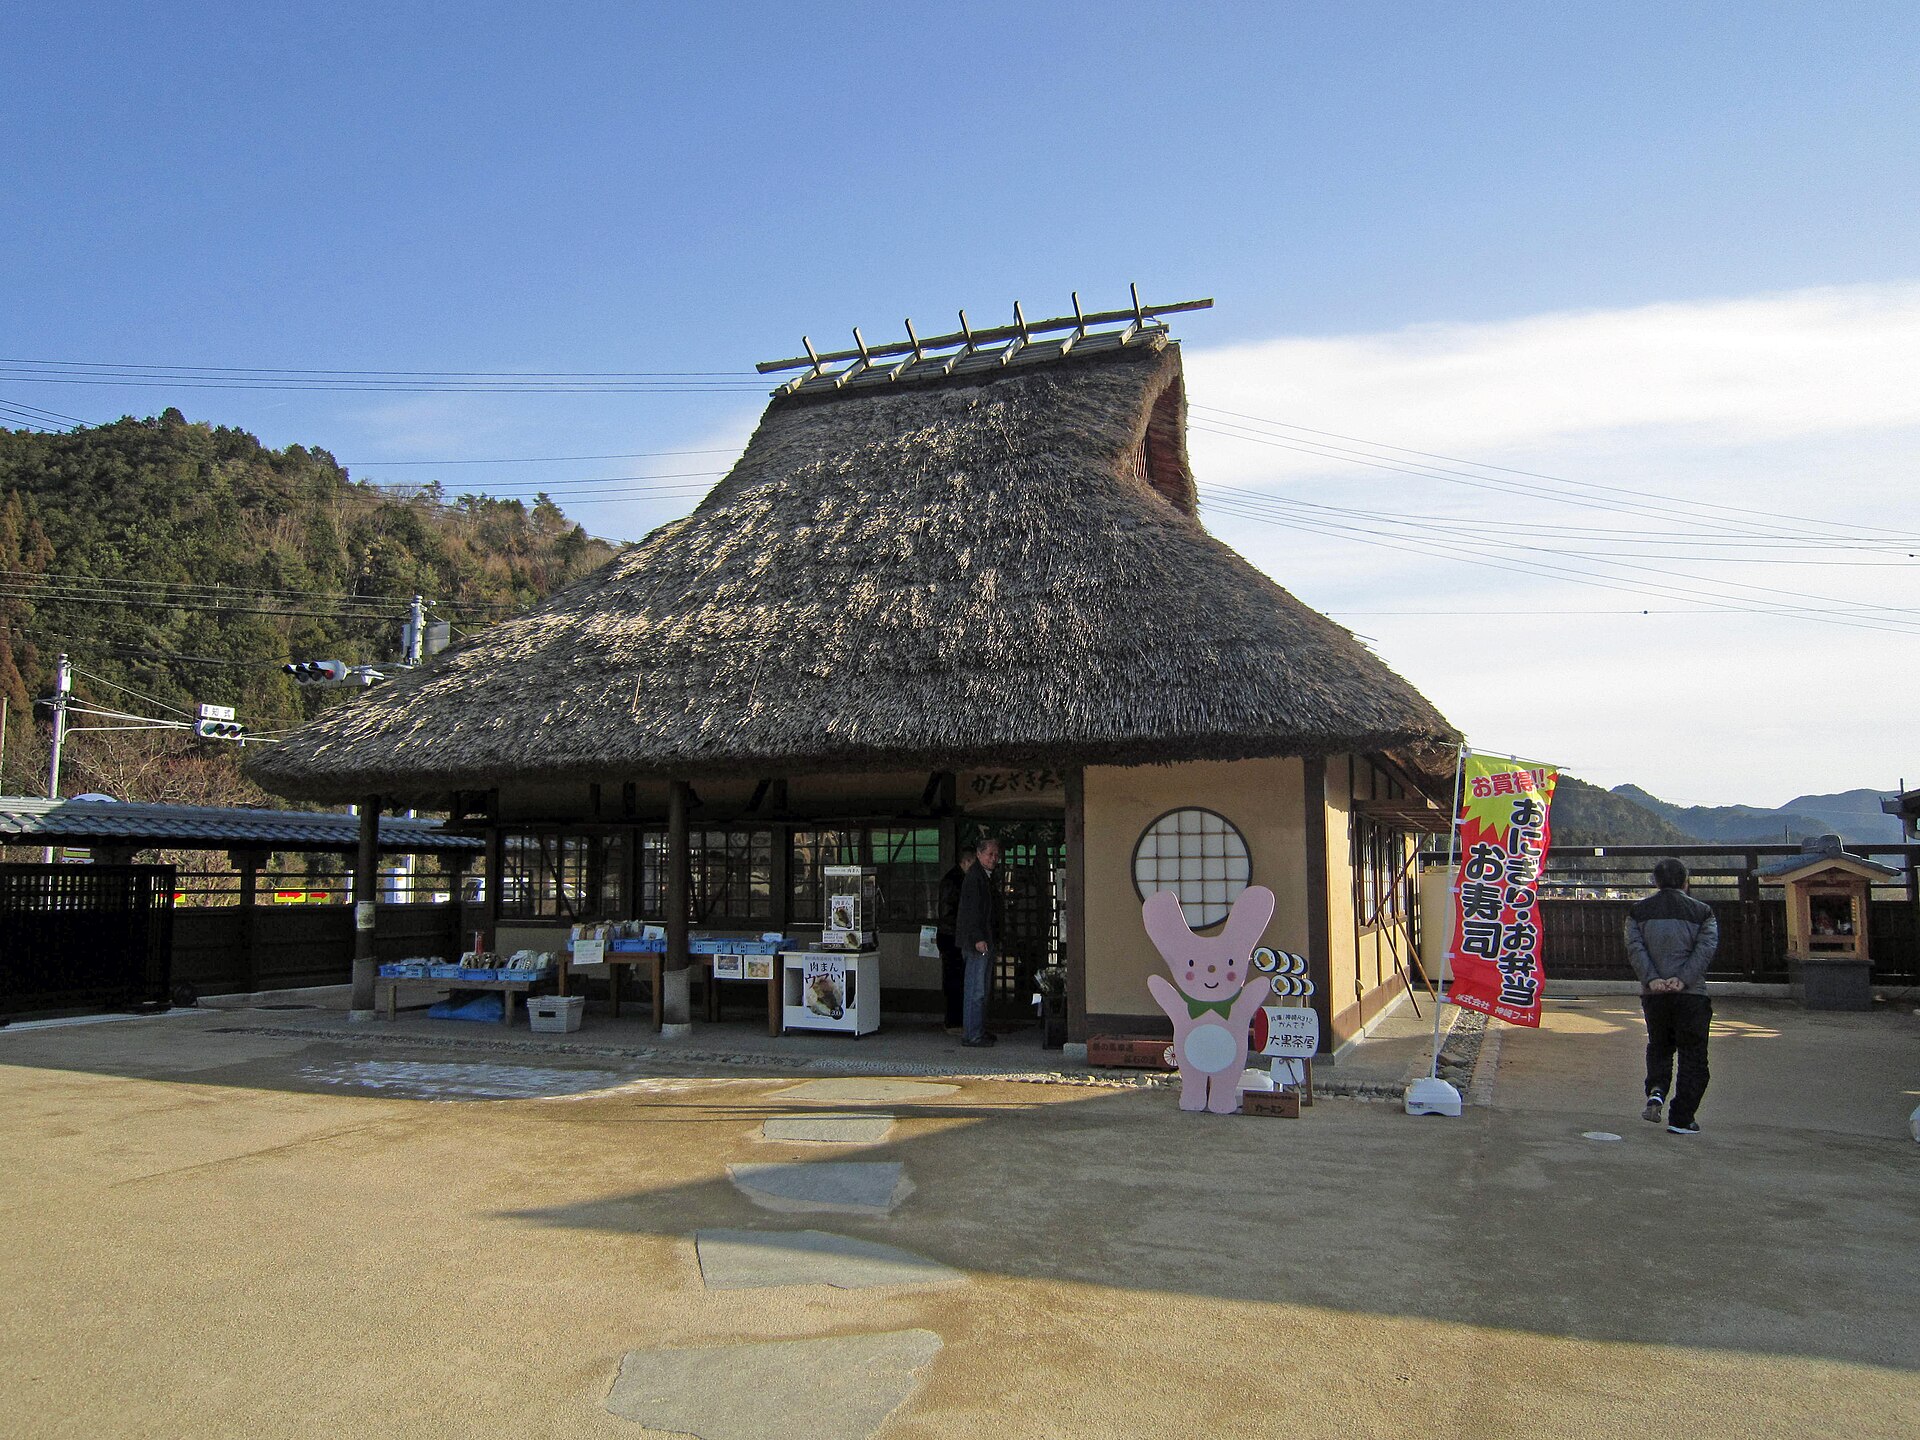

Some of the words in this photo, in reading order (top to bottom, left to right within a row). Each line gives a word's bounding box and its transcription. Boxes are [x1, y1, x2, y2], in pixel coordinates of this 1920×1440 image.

[1471, 768, 1545, 798] お買得!!
[1462, 842, 1506, 959] お寿司
[1498, 798, 1546, 1006] おにぎり・お弁当
[809, 961, 839, 972] 肉まん
[1269, 1034, 1315, 1049] 大黒茶屋
